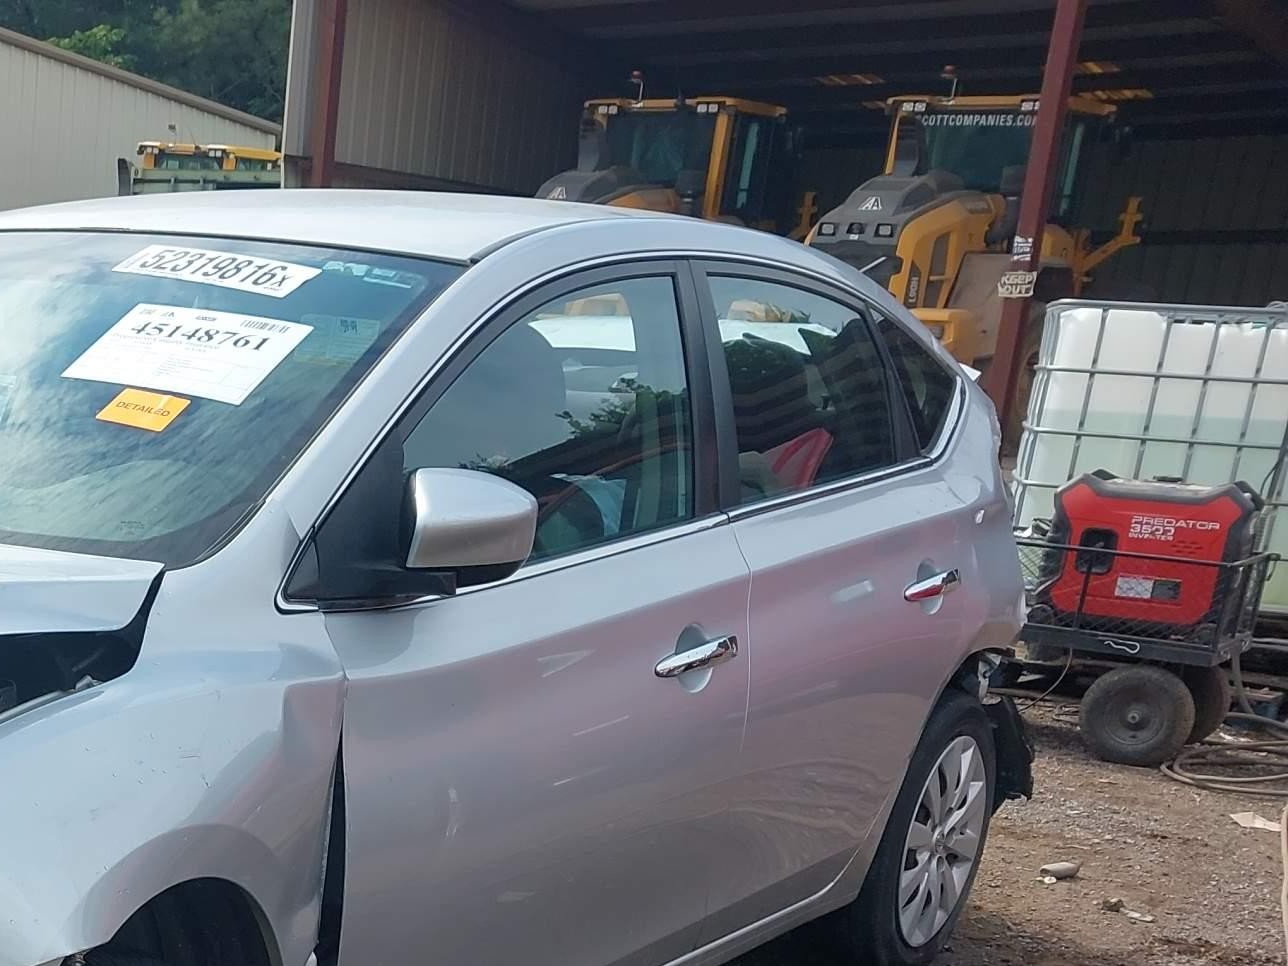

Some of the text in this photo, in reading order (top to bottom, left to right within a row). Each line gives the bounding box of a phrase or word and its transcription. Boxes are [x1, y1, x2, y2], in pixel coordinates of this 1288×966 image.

[916, 114, 1036, 126] COTTCOMPANIES.CO
[1004, 284, 1031, 294] OUT
[130, 321, 271, 351] 45148761
[115, 401, 171, 418] DETAILED
[1132, 515, 1220, 530] PREDATOR
[1130, 524, 1175, 536] 3500
